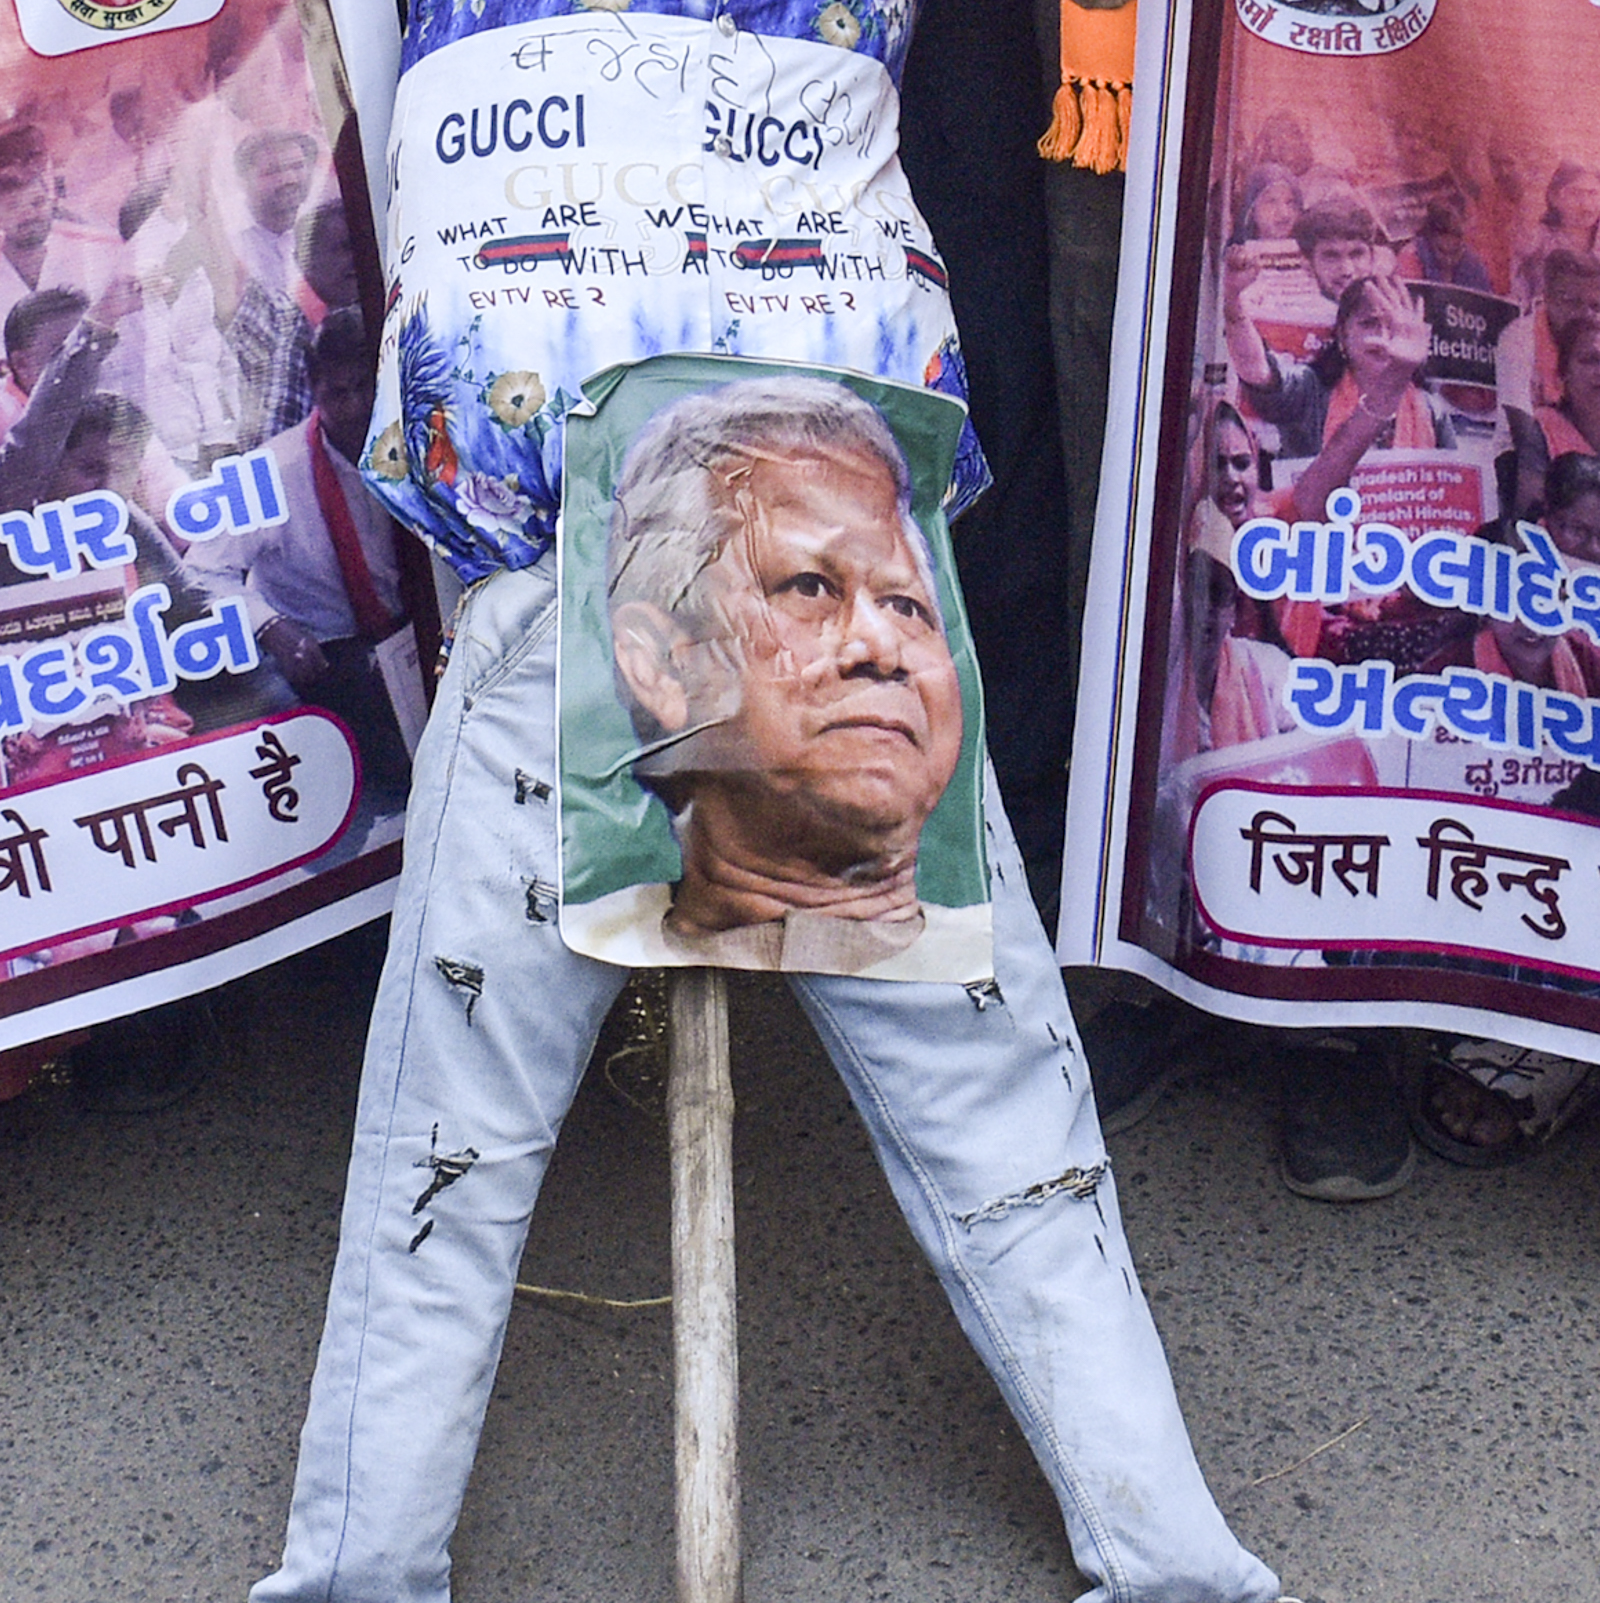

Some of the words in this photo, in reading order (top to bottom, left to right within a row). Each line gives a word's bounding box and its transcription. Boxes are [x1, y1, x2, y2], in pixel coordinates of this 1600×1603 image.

[1289, 21, 1363, 52] रक्षति
[435, 94, 587, 166] GUCCI
[701, 101, 821, 171] GUCCI
[437, 217, 509, 247] WHAT
[541, 201, 603, 229] ARE
[644, 202, 709, 229] WE
[796, 211, 850, 235] ARE
[875, 219, 917, 244] WE
[1445, 304, 1488, 337] Stop
[0, 488, 137, 582] પર
[166, 450, 289, 544] ના
[74, 762, 230, 871] पानी
[250, 729, 304, 824] है
[1240, 809, 1390, 901] जिस
[1418, 817, 1570, 942] हिन्दु
